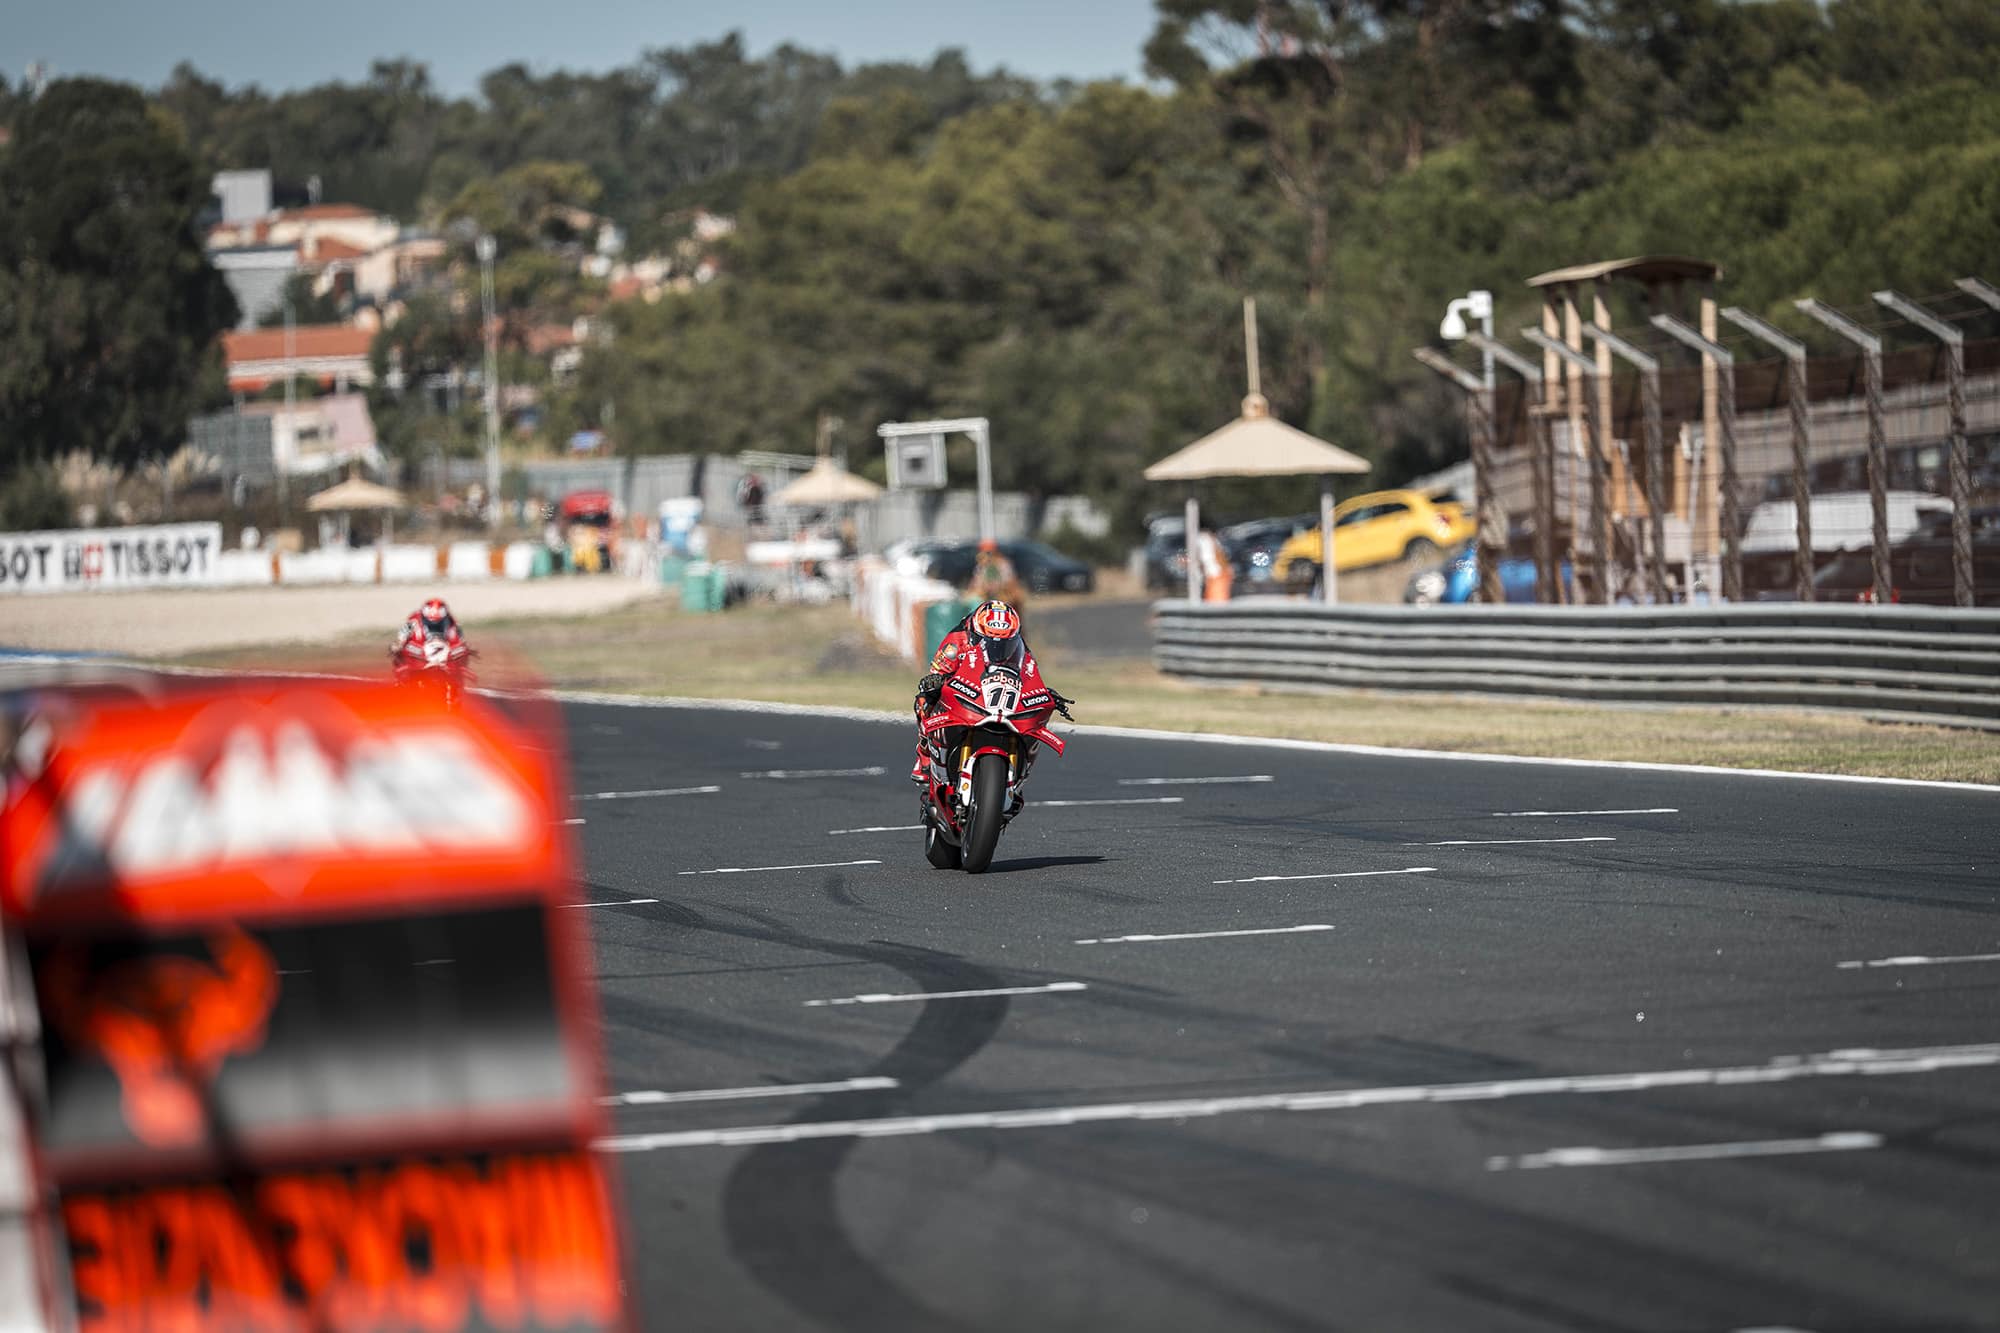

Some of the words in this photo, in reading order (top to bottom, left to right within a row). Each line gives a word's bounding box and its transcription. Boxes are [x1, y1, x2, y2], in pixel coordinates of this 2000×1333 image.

[110, 538, 209, 574] TISSOT
[950, 680, 977, 698] Lenovo
[981, 672, 1023, 690] aruba.it
[990, 687, 1017, 710] 11
[1023, 695, 1049, 707] Lenovo
